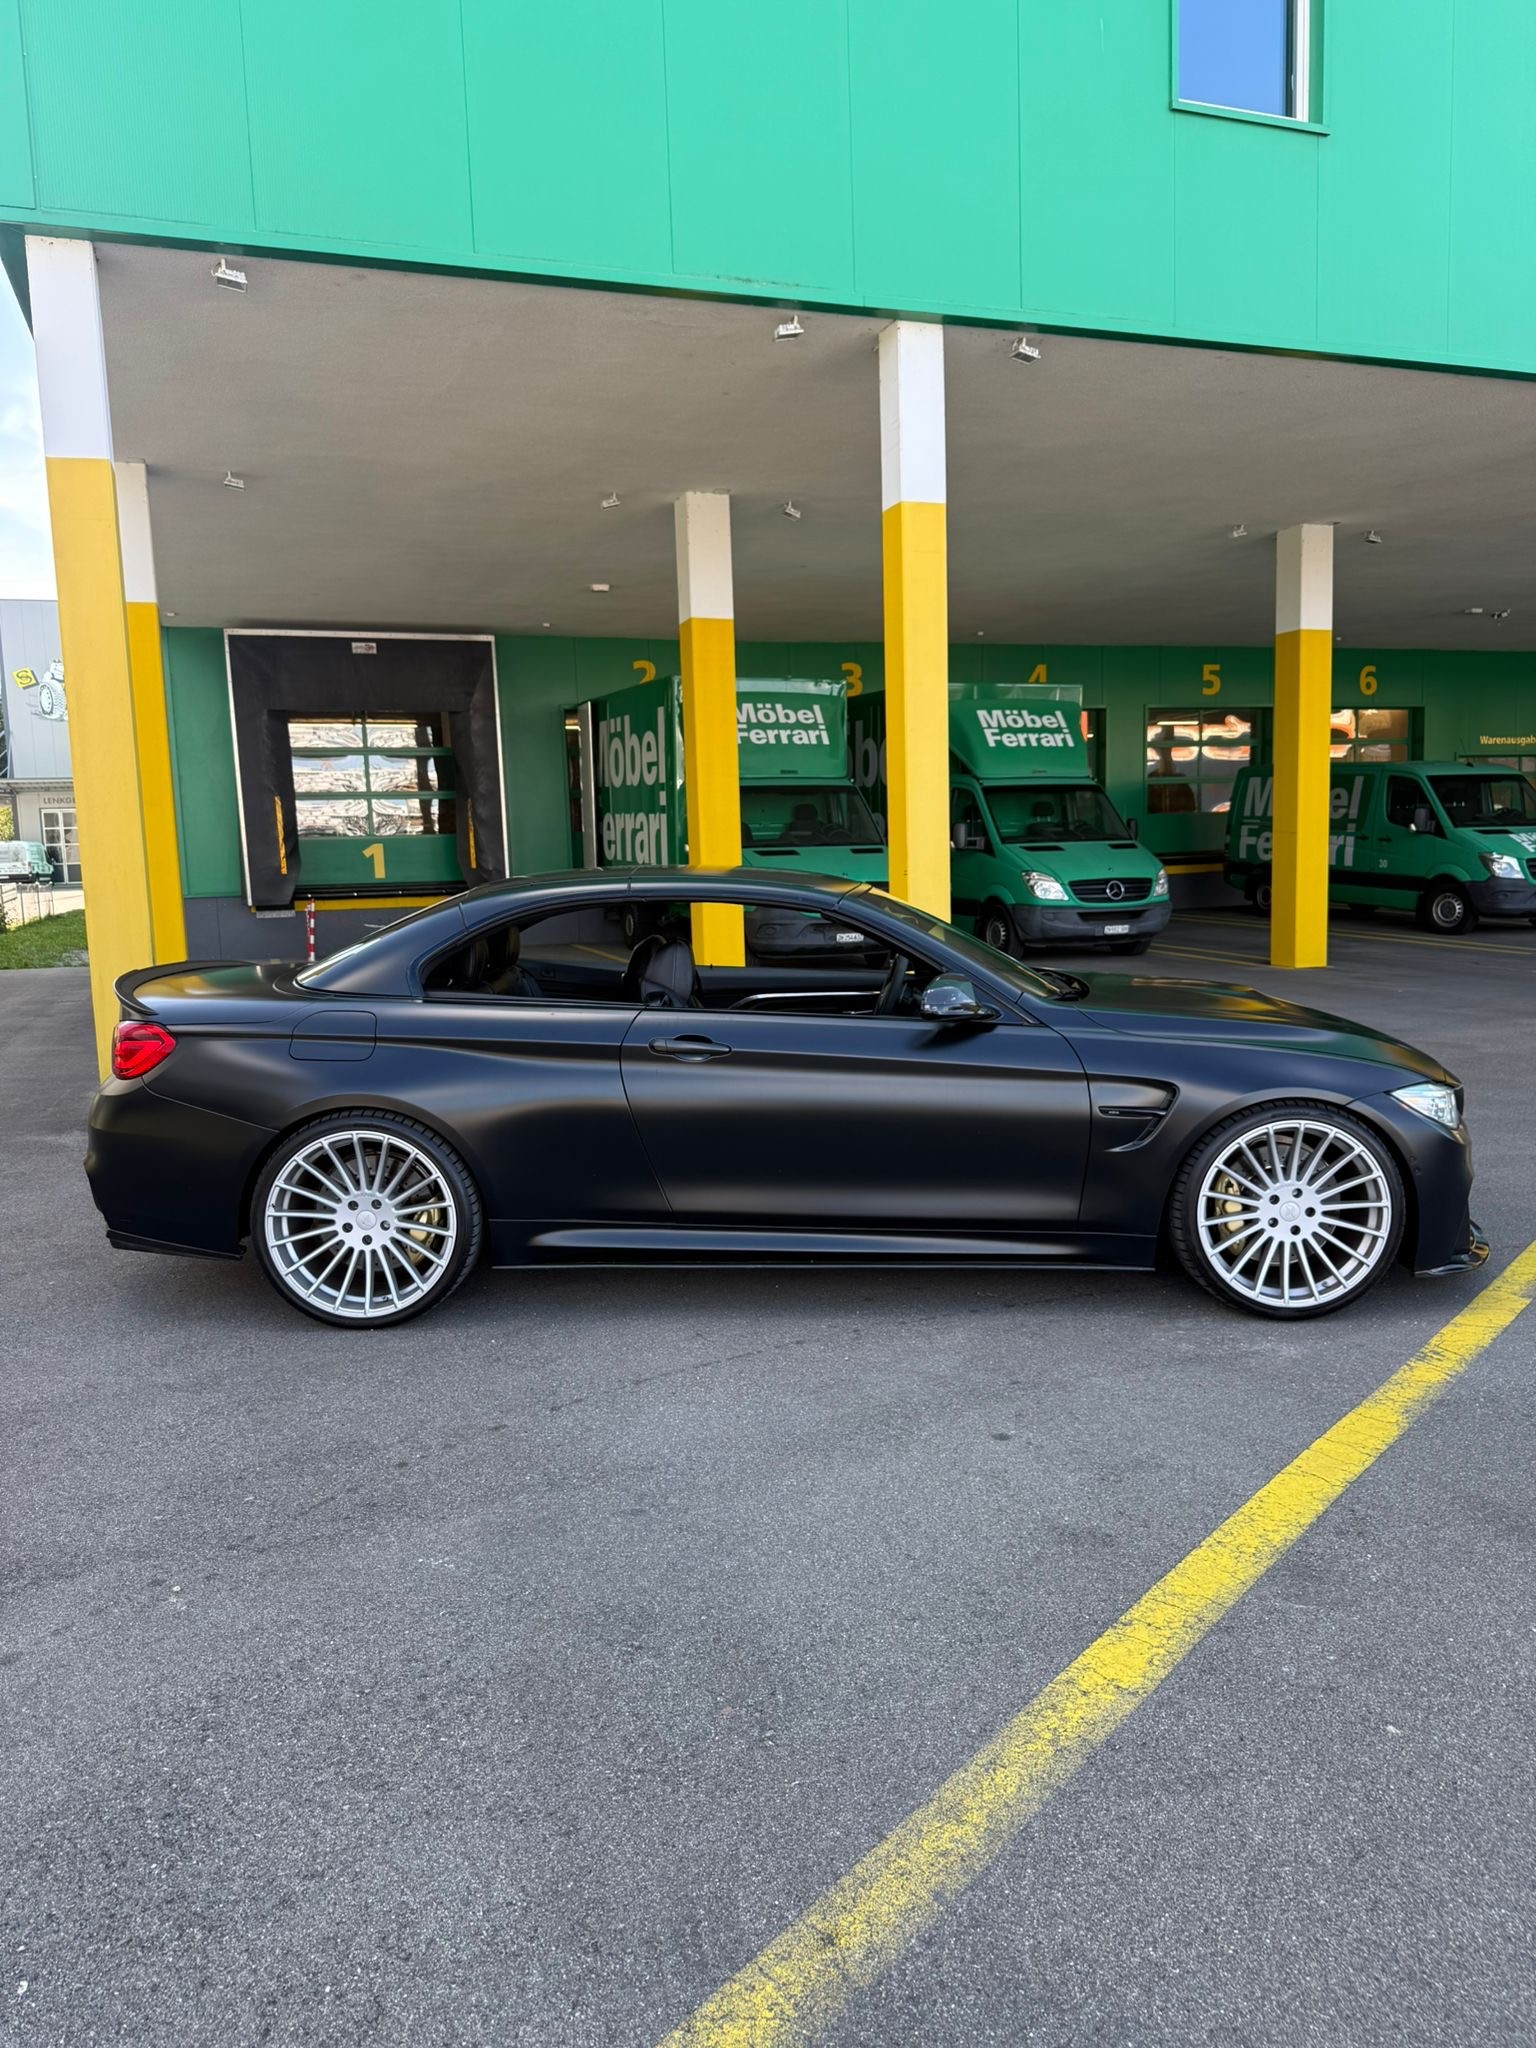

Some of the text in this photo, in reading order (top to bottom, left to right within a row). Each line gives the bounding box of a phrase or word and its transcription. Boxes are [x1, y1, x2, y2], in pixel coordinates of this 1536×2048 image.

[632, 660, 657, 684] 2
[841, 662, 863, 697] 3
[1201, 664, 1222, 696] 5
[1358, 665, 1378, 697] 6
[976, 709, 1068, 728] Möbel
[983, 728, 1075, 747] Ferrari
[603, 791, 668, 868] errari
[361, 843, 386, 879] 1
